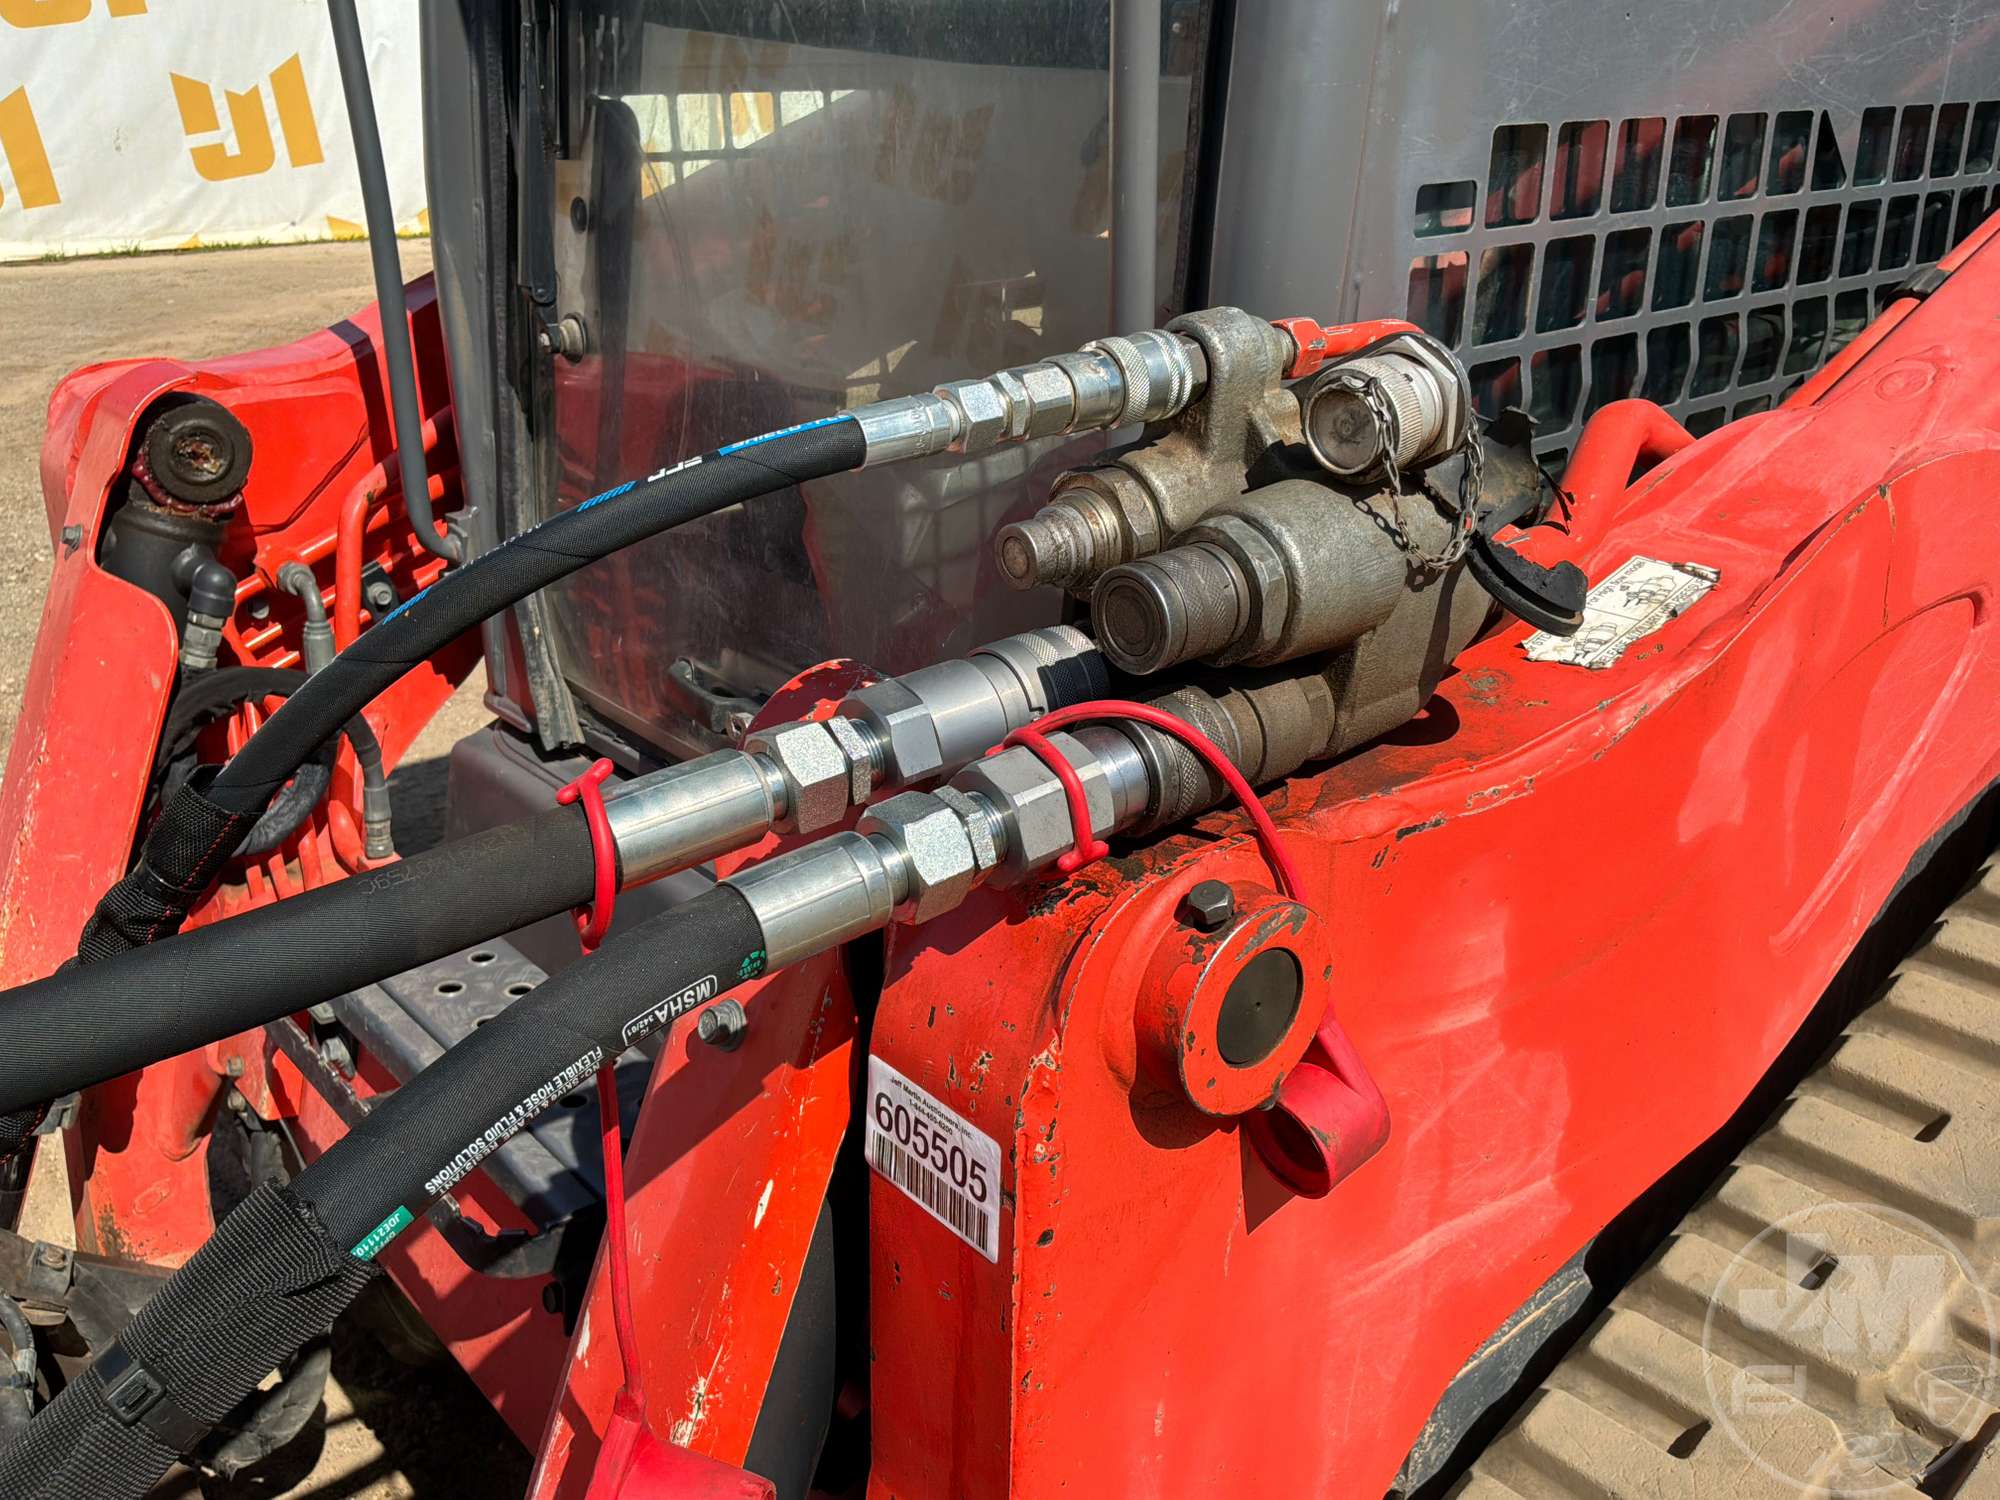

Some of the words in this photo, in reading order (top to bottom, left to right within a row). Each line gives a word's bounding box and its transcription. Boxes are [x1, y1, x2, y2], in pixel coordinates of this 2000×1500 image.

[653, 979, 715, 1024] MSHA
[550, 1045, 604, 1088] FLEXIBLE
[512, 1102, 526, 1117] &
[522, 1080, 556, 1111] HOSE
[481, 1109, 518, 1144] FLUID
[875, 1092, 987, 1203] 605505
[423, 1135, 486, 1195] SOLUTIONS
